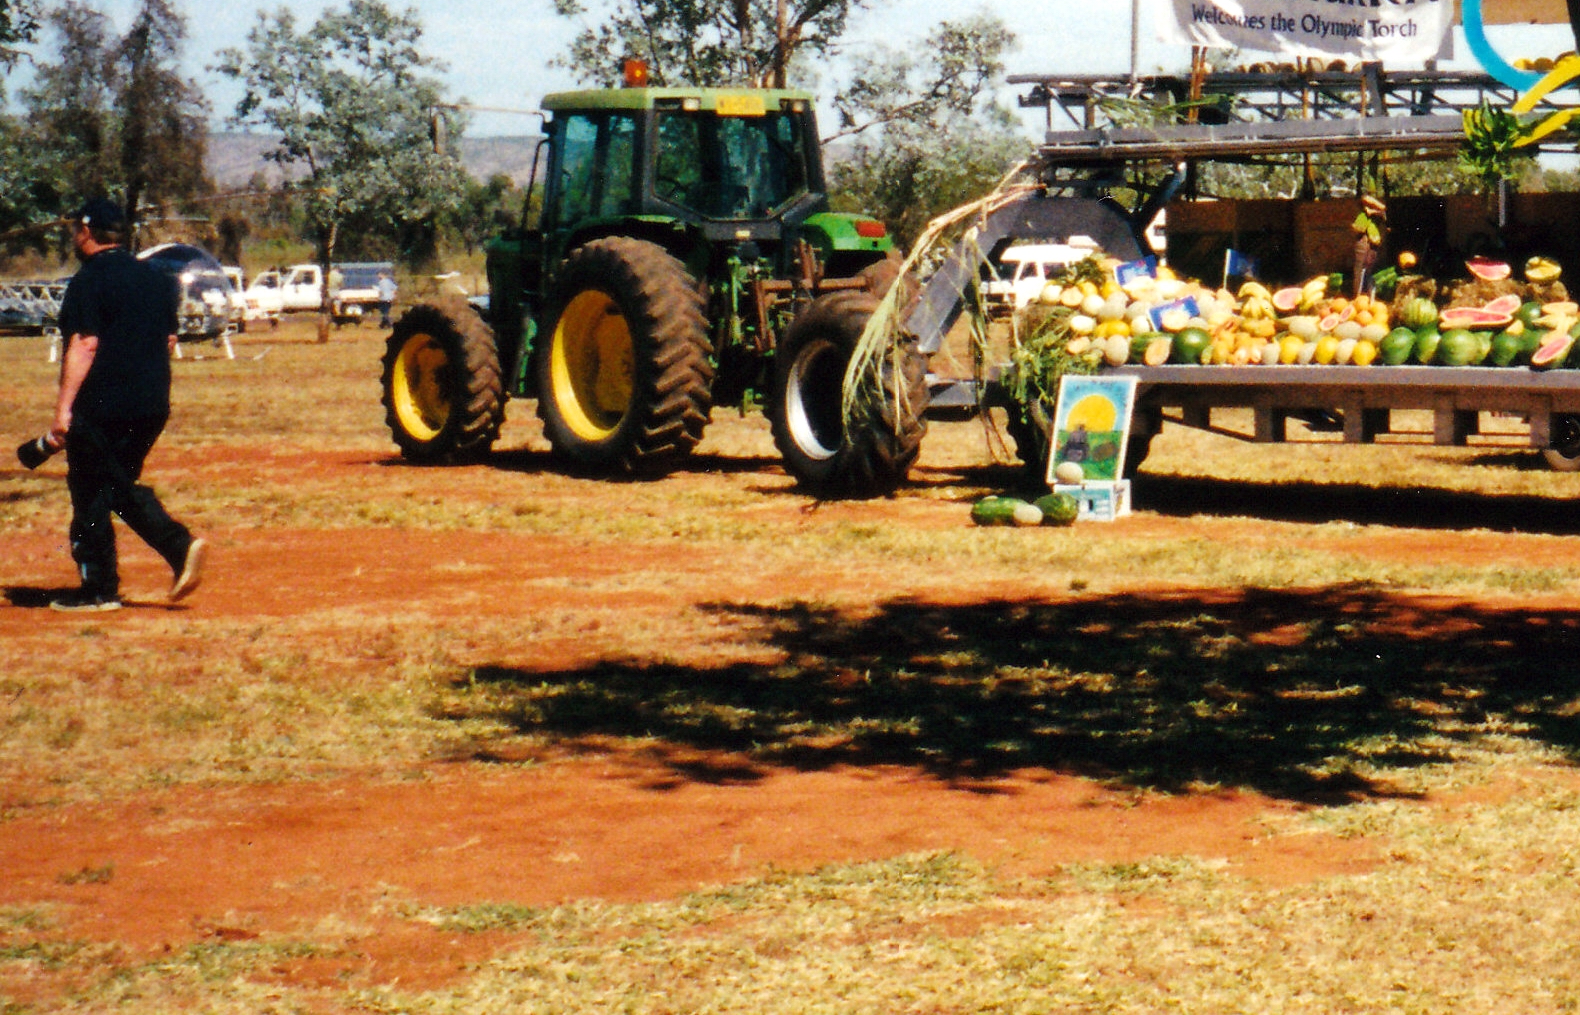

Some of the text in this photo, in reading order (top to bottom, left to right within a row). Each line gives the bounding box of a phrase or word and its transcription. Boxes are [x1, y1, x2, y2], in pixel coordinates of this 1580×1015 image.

[1192, 3, 1417, 39] Welcomes the Olympic Torch
